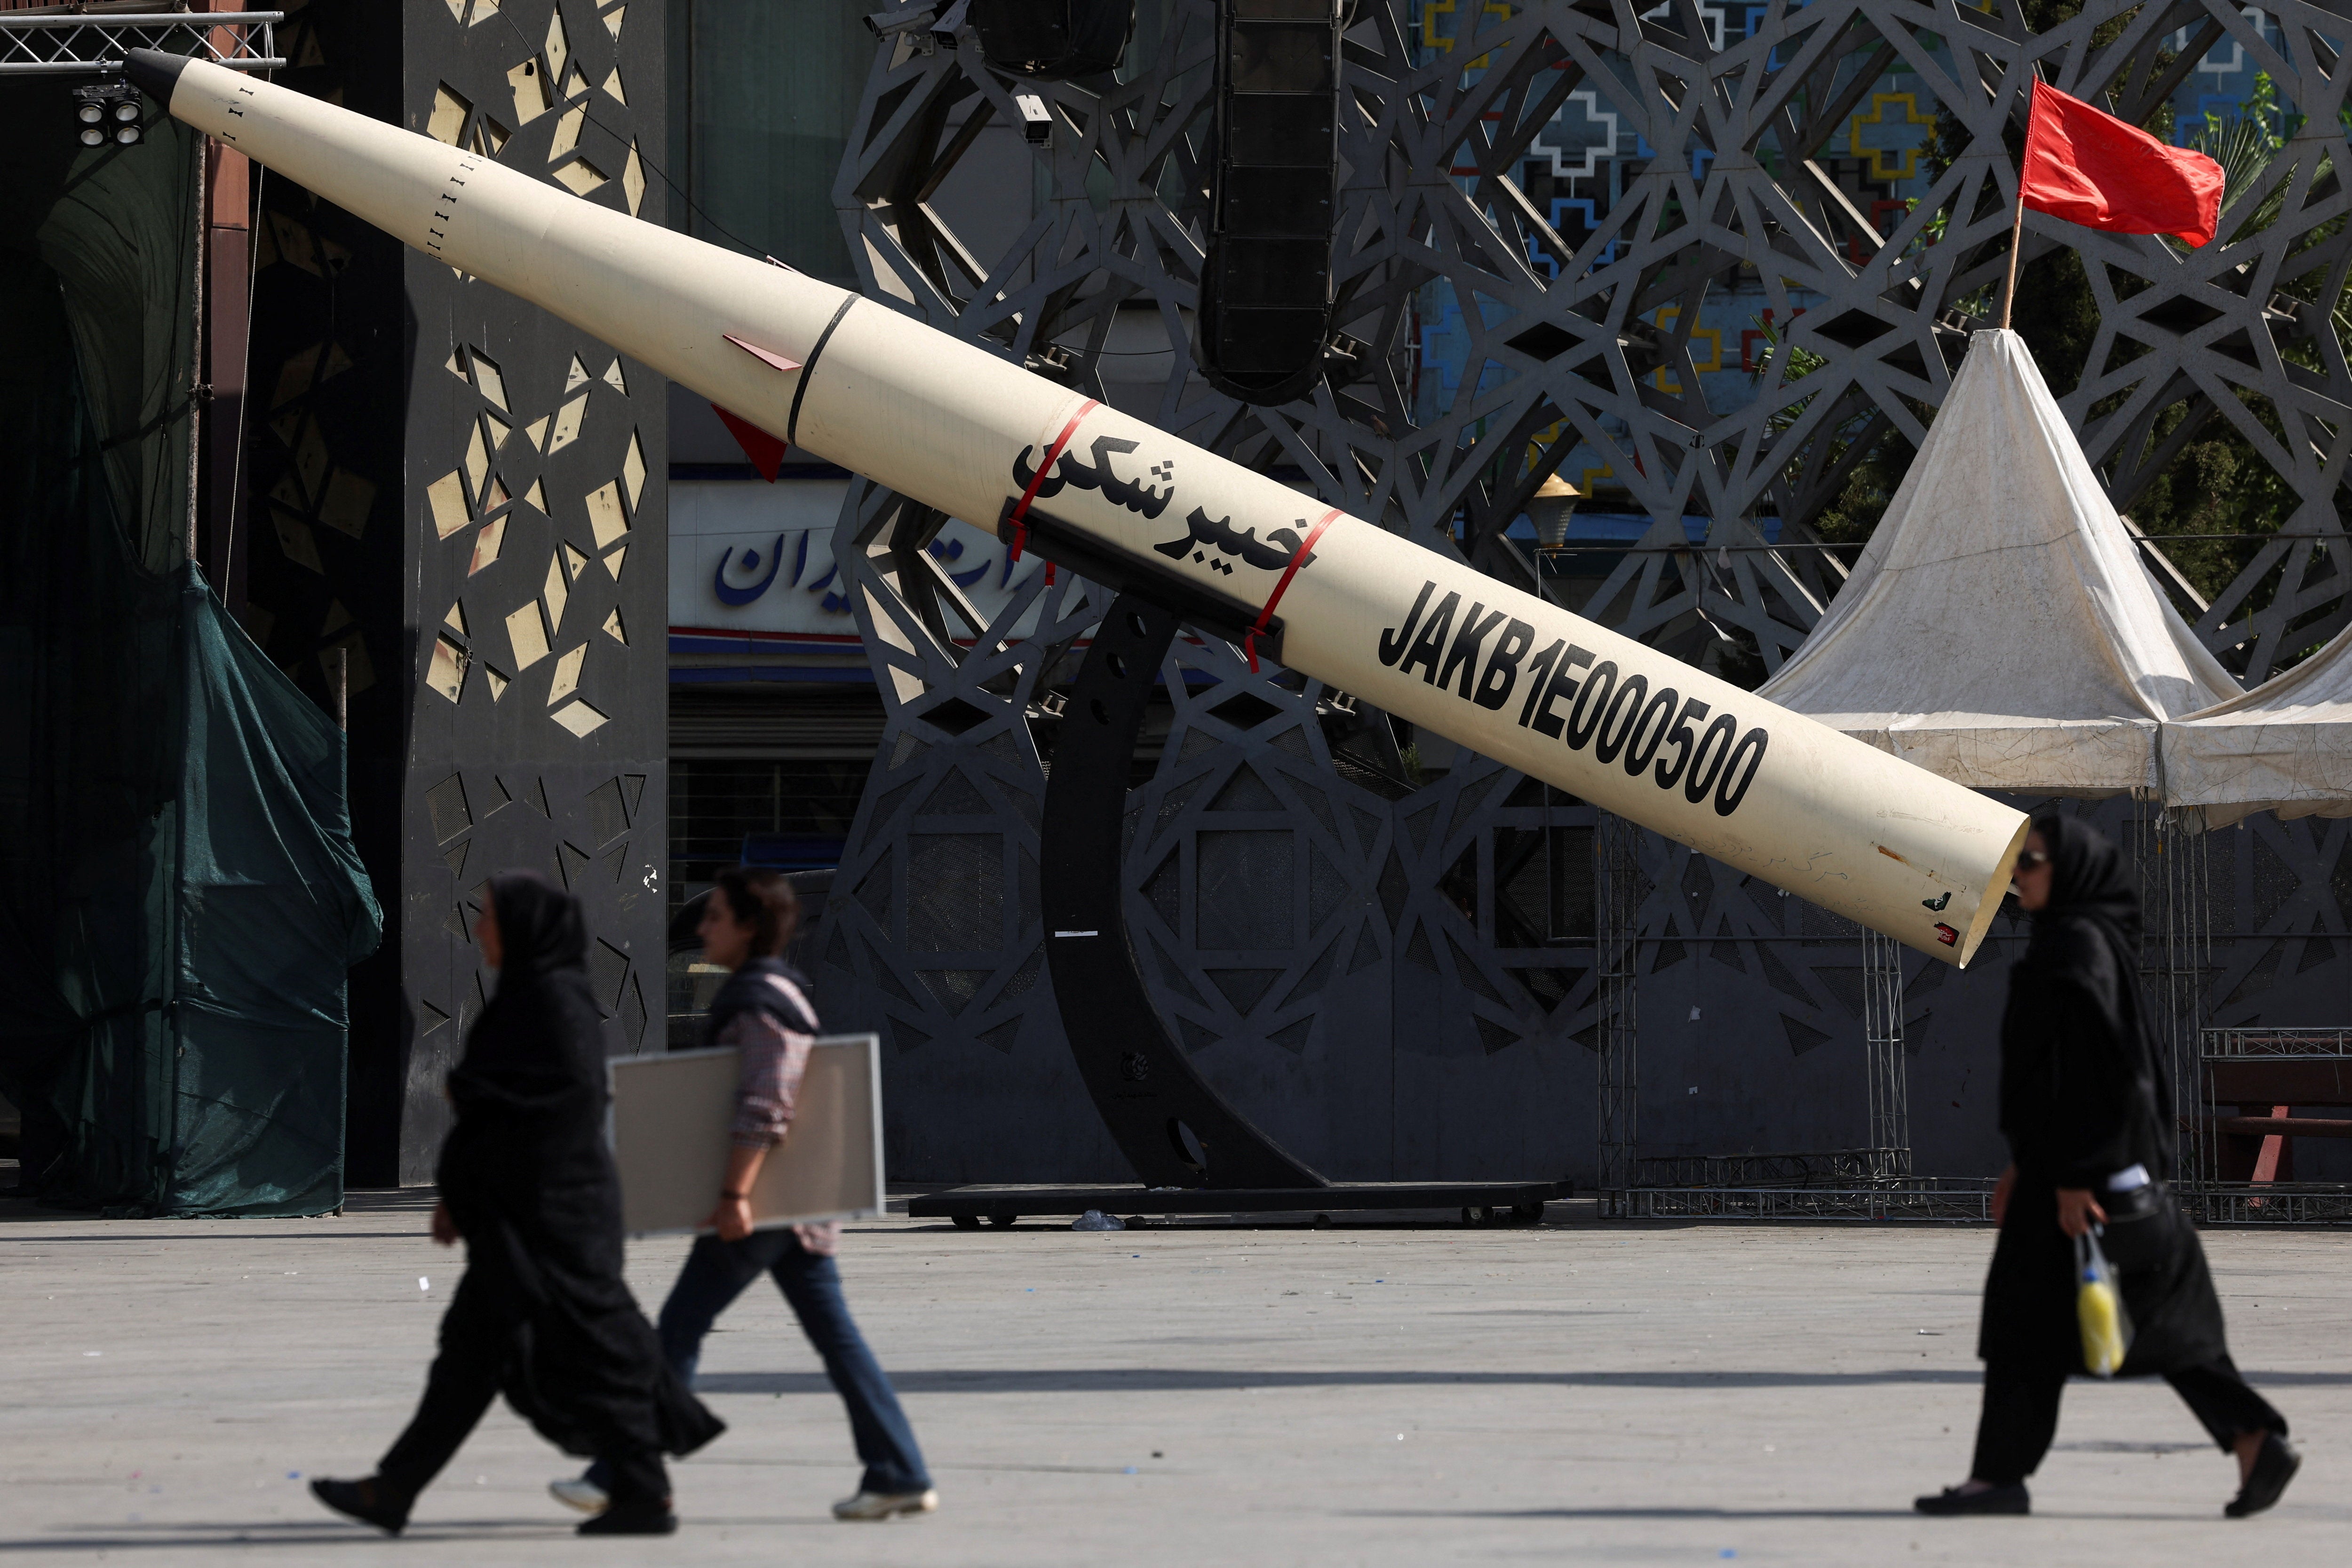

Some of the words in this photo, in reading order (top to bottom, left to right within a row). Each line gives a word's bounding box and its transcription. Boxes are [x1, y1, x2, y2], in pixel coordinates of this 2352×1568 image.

[1013, 435, 1175, 519] شکن
[715, 529, 853, 614] ران
[1154, 506, 1318, 576] خیبر
[1378, 580, 1769, 817] JAKB1E000500
